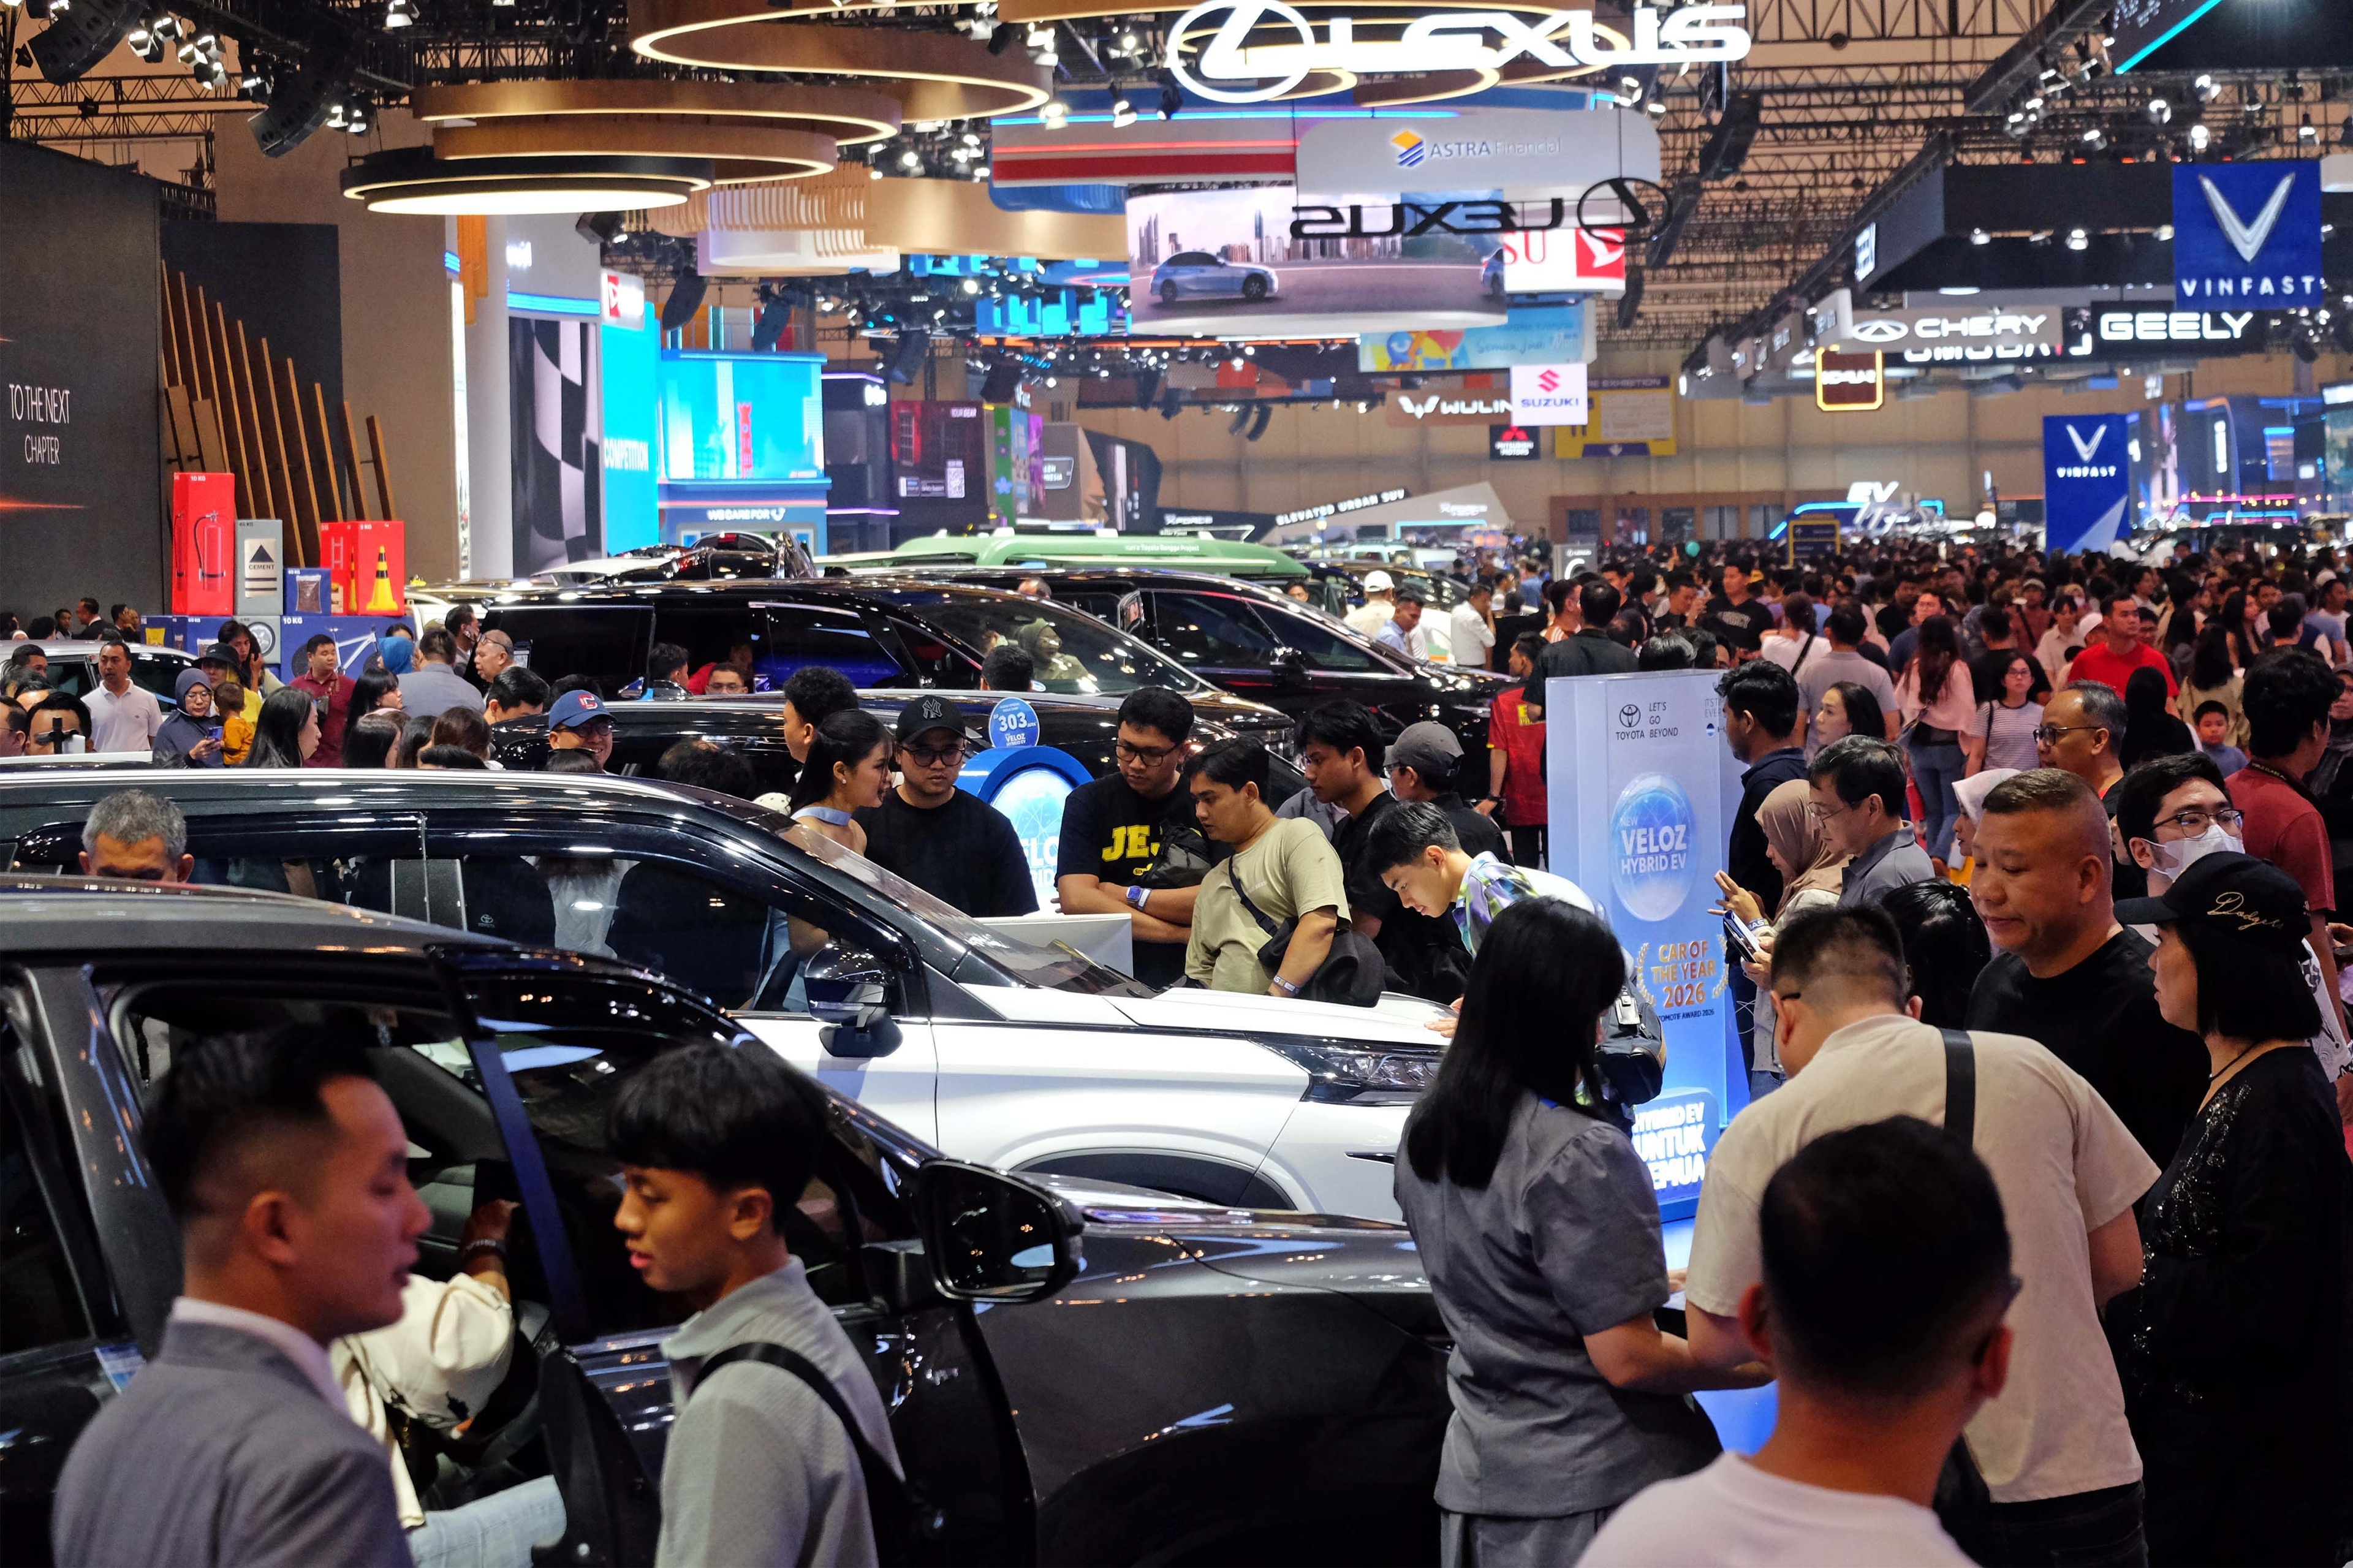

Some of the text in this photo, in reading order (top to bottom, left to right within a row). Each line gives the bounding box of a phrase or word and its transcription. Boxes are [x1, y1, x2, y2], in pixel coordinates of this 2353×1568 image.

[1329, 5, 1751, 72] LEXUS
[1430, 137, 1562, 157] ASTRA Financial
[2181, 275, 2316, 297] VINFAST
[1914, 314, 2047, 338] CHERY
[2100, 311, 2254, 340] GEELY
[9, 384, 70, 424] TO THE NEXT
[1441, 399, 1514, 415] WULIN
[1521, 398, 1579, 407] SUZUKI
[25, 434, 60, 464] CHAPTER
[2056, 466, 2117, 478] VINFAST
[1846, 481, 1900, 502] EV
[1276, 488, 1405, 526] ELEVATED URBAN SUV
[1649, 702, 1667, 712] LET'S
[998, 712, 1028, 732] 303
[1650, 716, 1661, 725] GO
[1006, 733, 1026, 742] VELOZ
[1616, 730, 1645, 741] TOYOTA
[1650, 727, 1679, 738] BEYOND
[1620, 816, 1638, 827] NEW
[1621, 824, 1687, 856] VELOZ
[1621, 852, 1687, 875] HYBRID EV
[1659, 941, 1708, 963] CAR OF
[1650, 959, 1716, 985] THE YEAR
[1663, 982, 1706, 1009] 2026
[1682, 1010, 1702, 1020] AWARD
[1685, 1102, 1705, 1124] EV
[1631, 1123, 1707, 1162] UNTUK
[1647, 1153, 1706, 1191] EMUA
